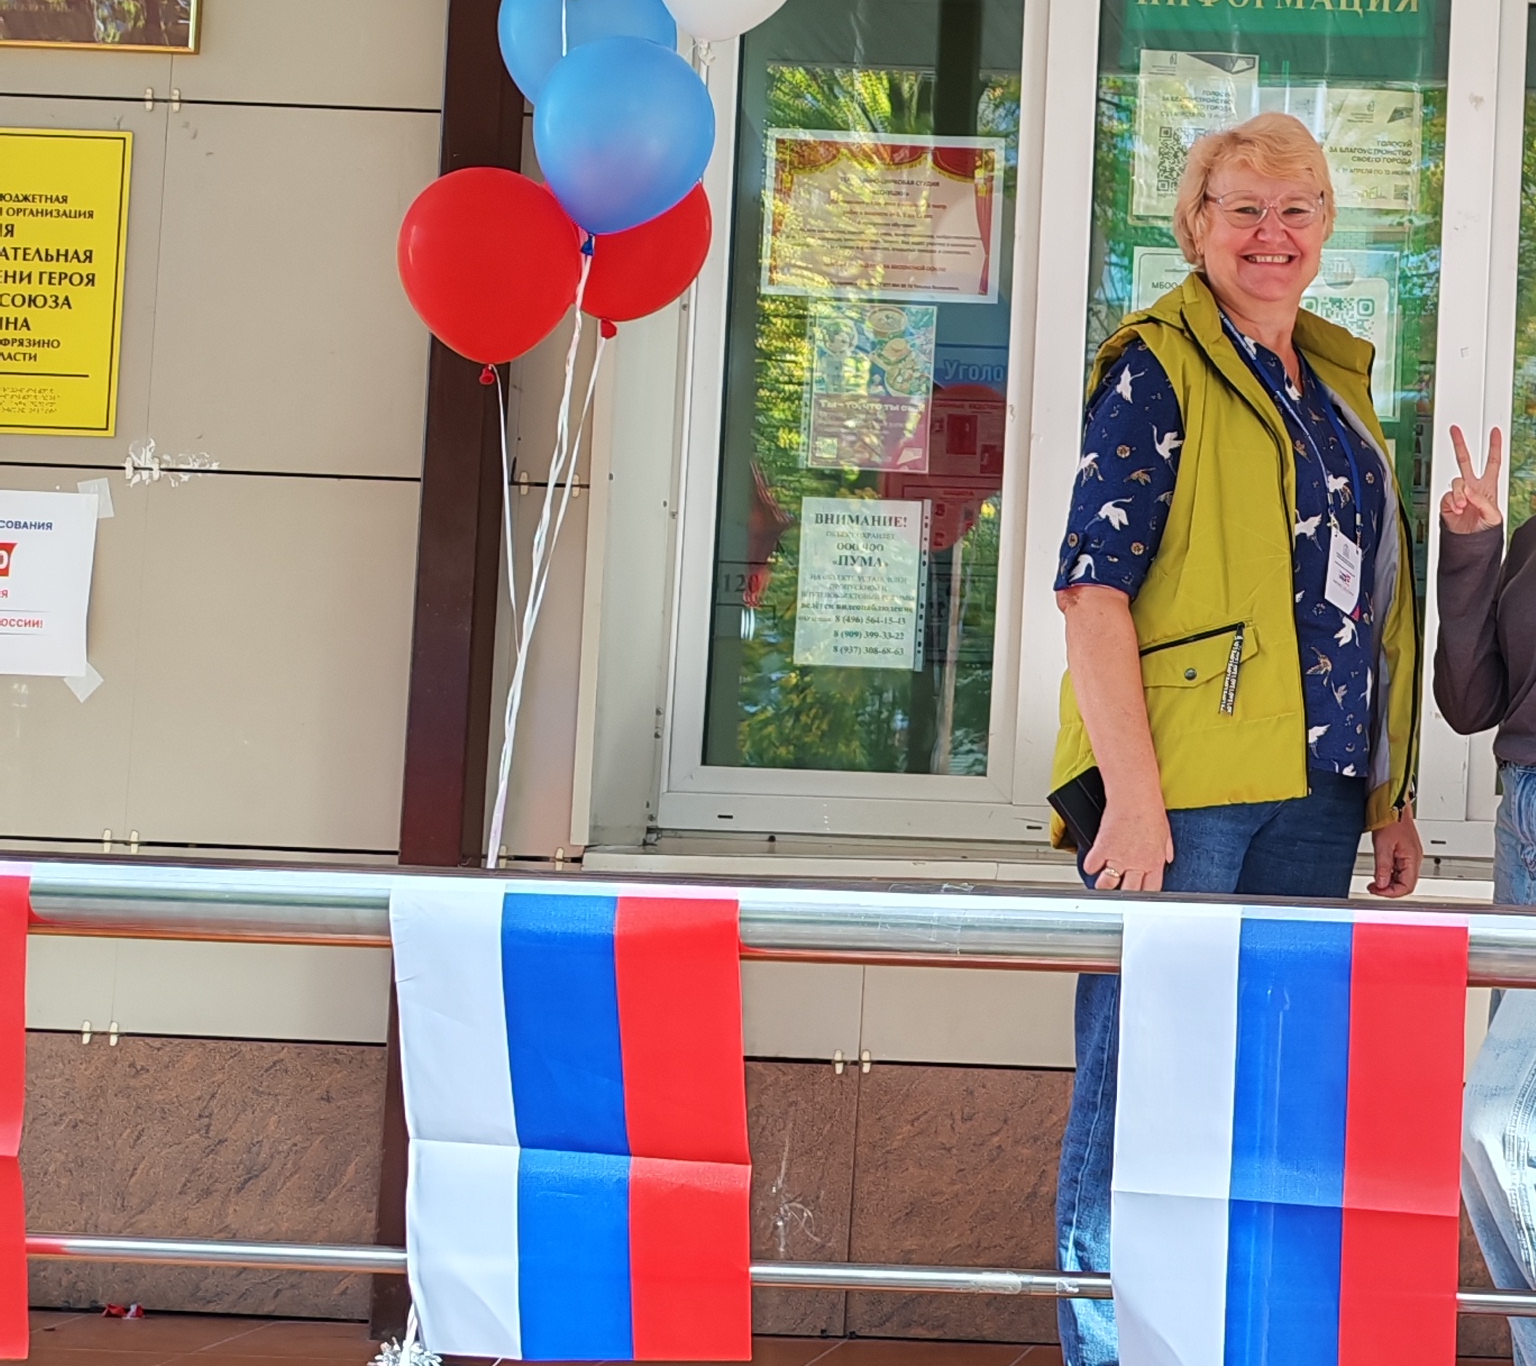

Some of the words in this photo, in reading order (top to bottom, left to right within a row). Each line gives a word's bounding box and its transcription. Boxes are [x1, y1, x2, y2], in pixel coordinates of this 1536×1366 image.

[6, 206, 95, 220] ОРГАНИЗАЦИЯ
[0, 270, 32, 285] НИ
[38, 271, 96, 287] ГЕРОЯ
[0, 292, 73, 310] СОЮЗА
[815, 512, 908, 528] ВНИМАНИЕ!
[0, 618, 43, 629] ОССИИ!
